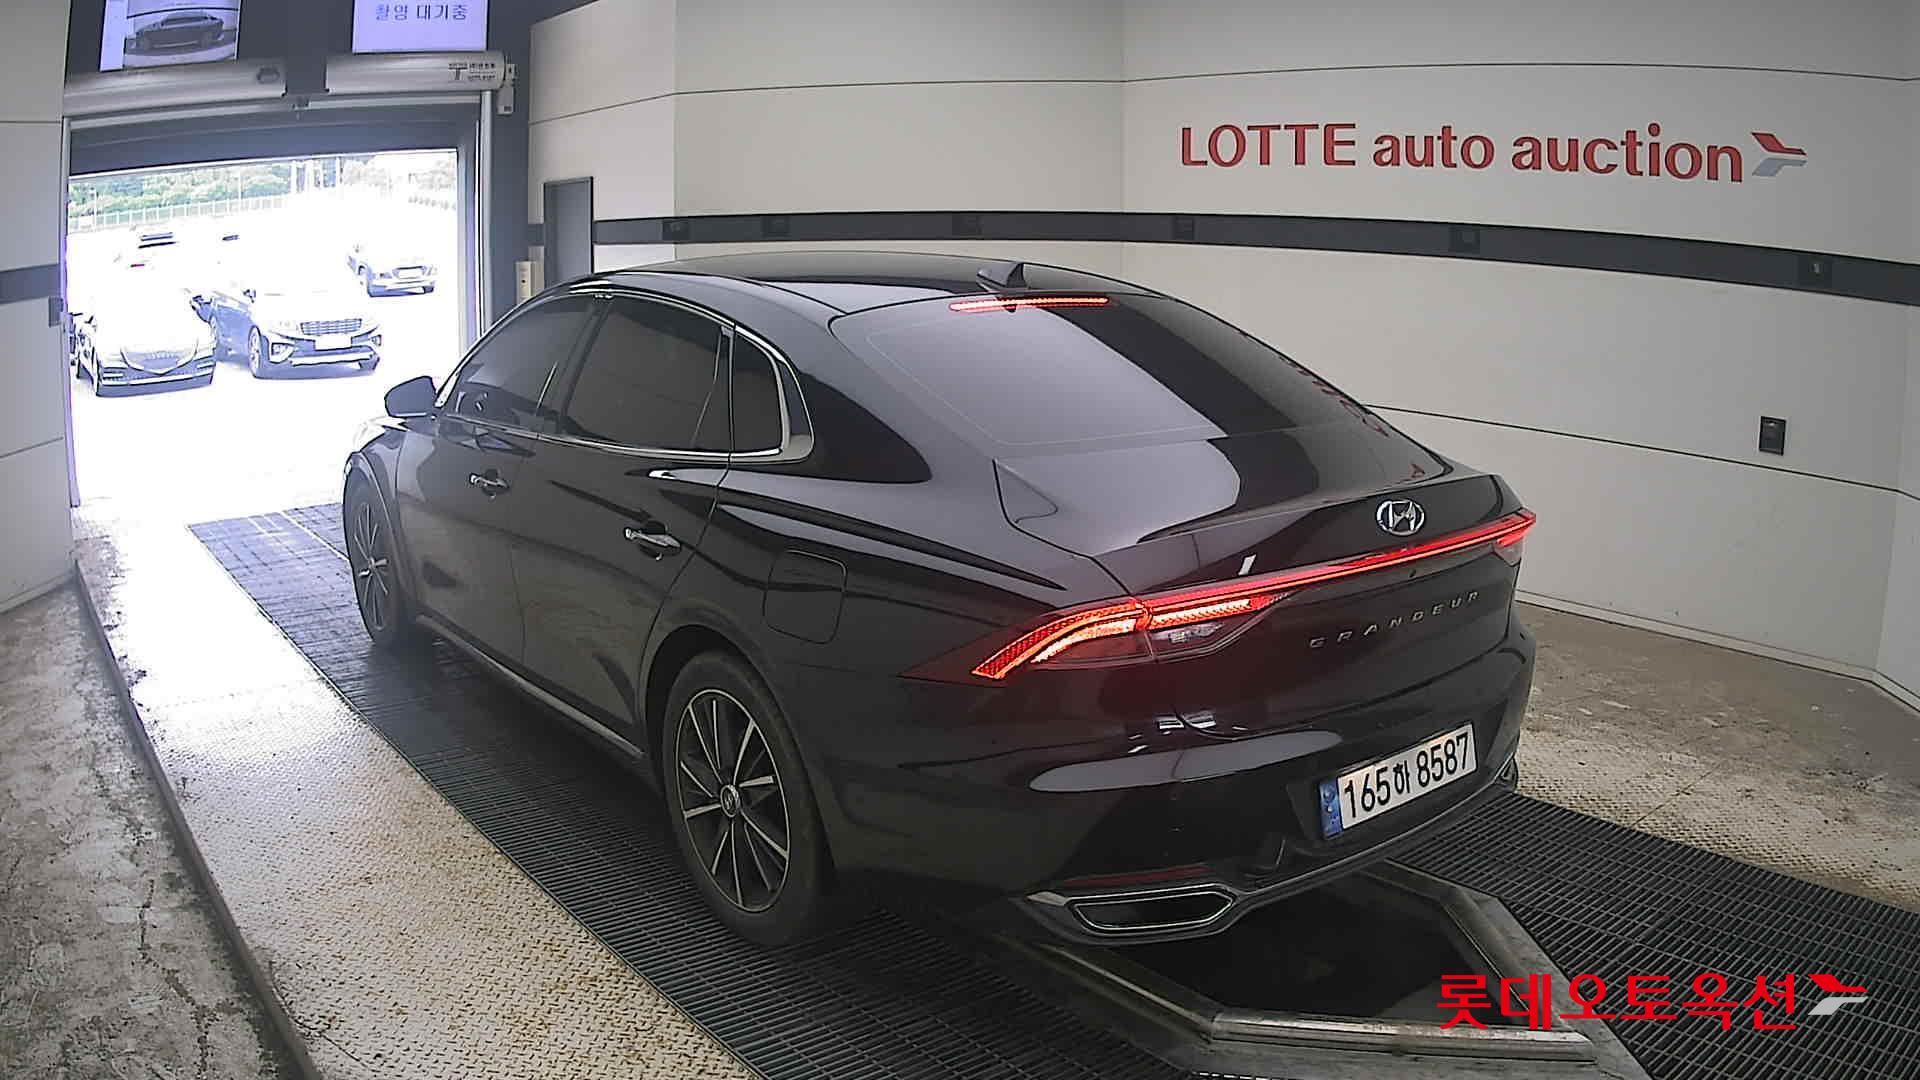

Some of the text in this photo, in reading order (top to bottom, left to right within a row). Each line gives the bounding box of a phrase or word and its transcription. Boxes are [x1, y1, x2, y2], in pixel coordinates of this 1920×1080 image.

[416, 4, 467, 21] 대기중
[1181, 122, 1744, 183] LOTTE auto auction
[1309, 590, 1480, 649] GRANDEUR
[1343, 731, 1470, 819] 165하 8587
